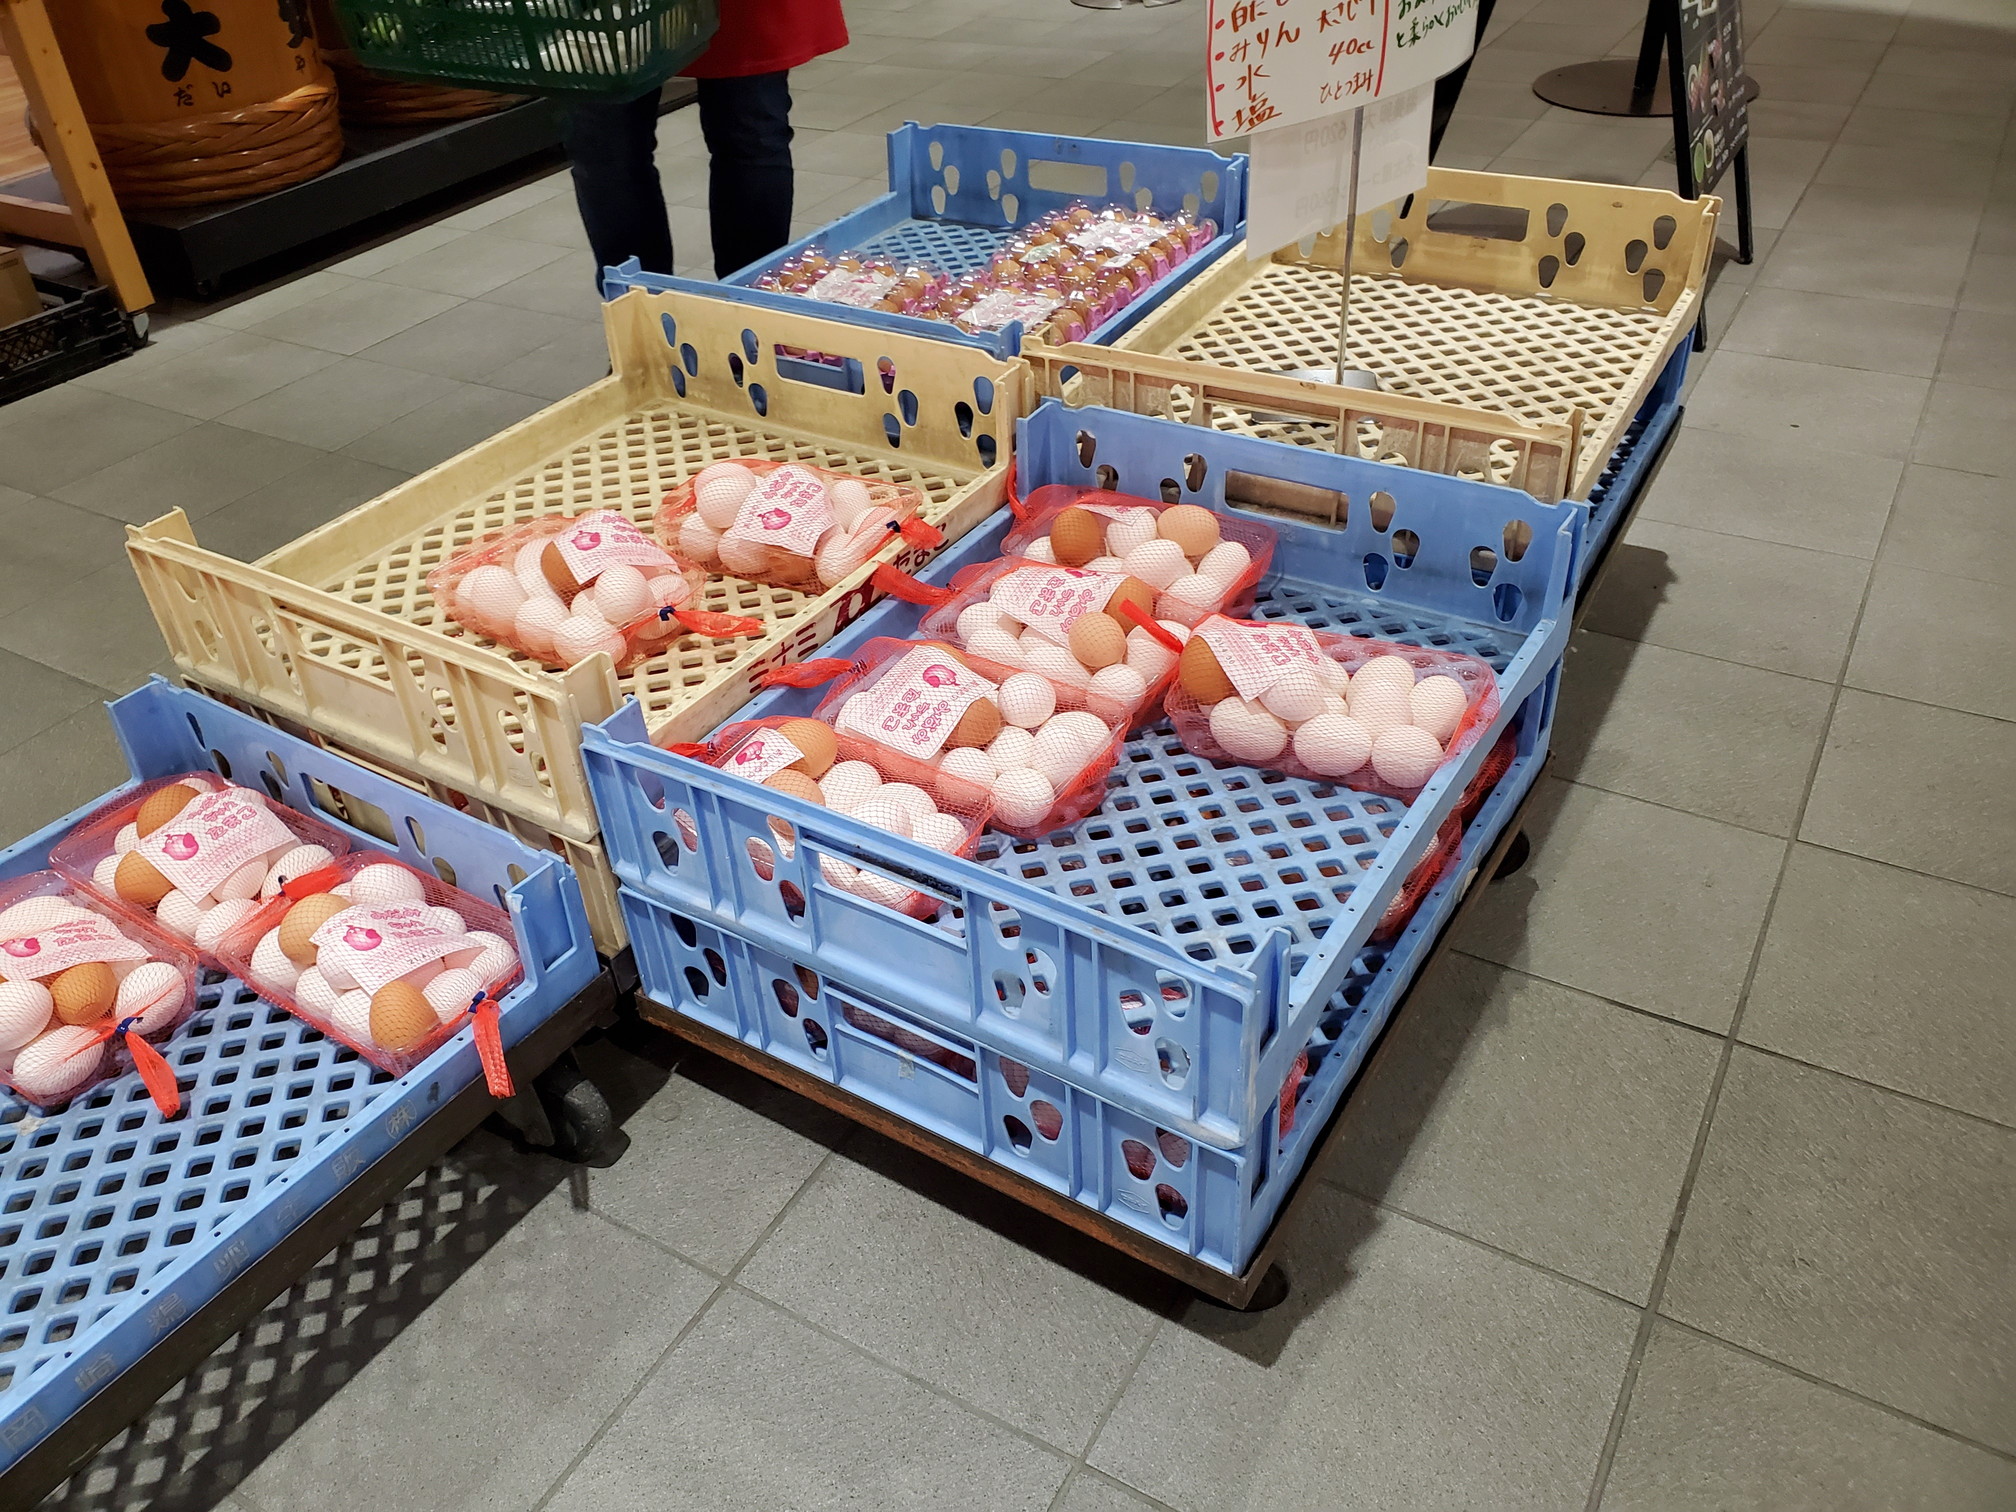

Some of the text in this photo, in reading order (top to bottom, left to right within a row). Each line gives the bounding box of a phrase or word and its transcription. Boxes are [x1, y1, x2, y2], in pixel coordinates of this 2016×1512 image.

[145, 0, 232, 82] 大
[1229, 20, 1300, 63] みりん
[1235, 64, 1271, 100] 水
[1231, 92, 1282, 133] 塩
